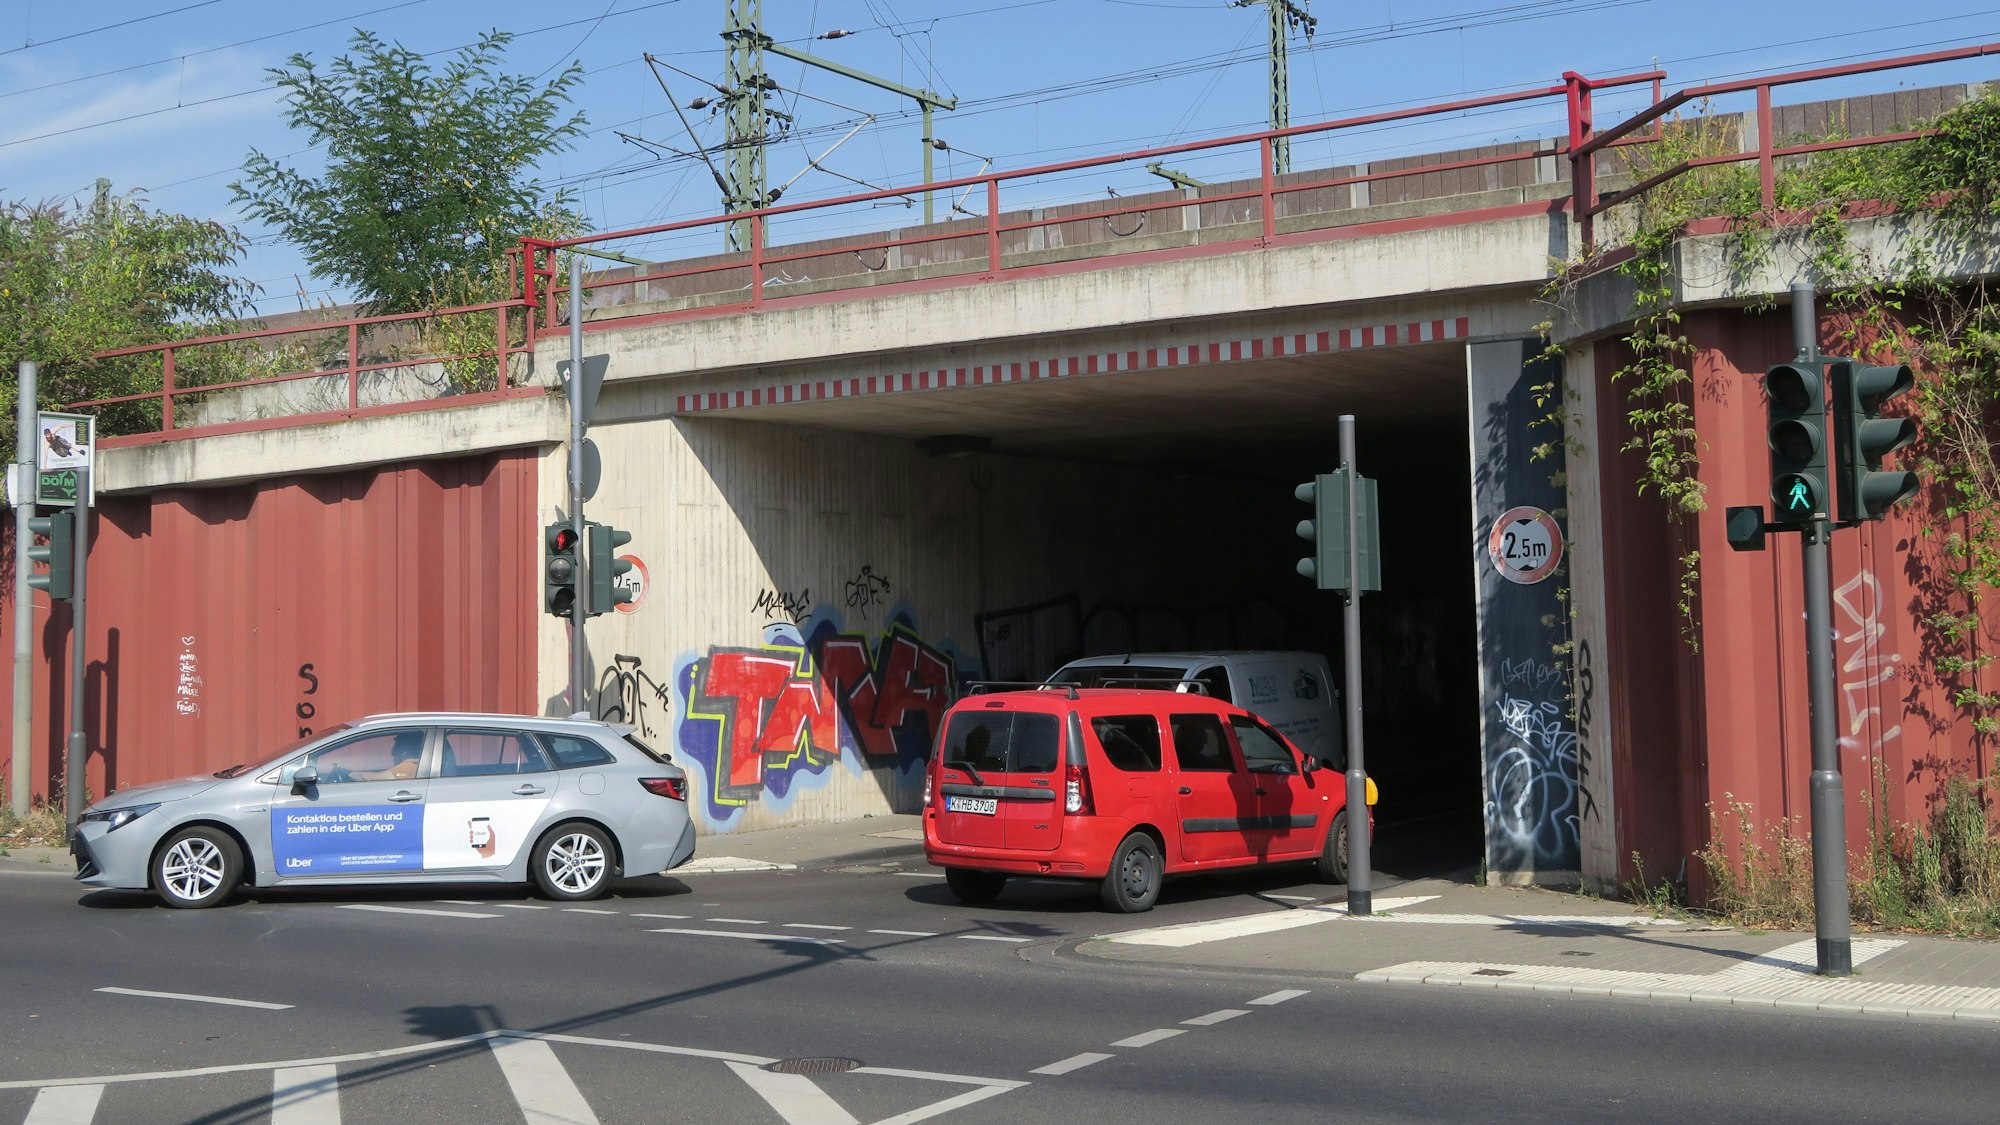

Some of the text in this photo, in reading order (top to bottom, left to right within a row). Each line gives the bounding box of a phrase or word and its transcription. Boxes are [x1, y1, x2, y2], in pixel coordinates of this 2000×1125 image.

[951, 799, 957, 810] K
[962, 800, 973, 811] HB
[287, 811, 403, 824] Kontaktlos bestellen und
[287, 822, 395, 835] zahlen in der Uber App
[286, 857, 312, 868] Uber
